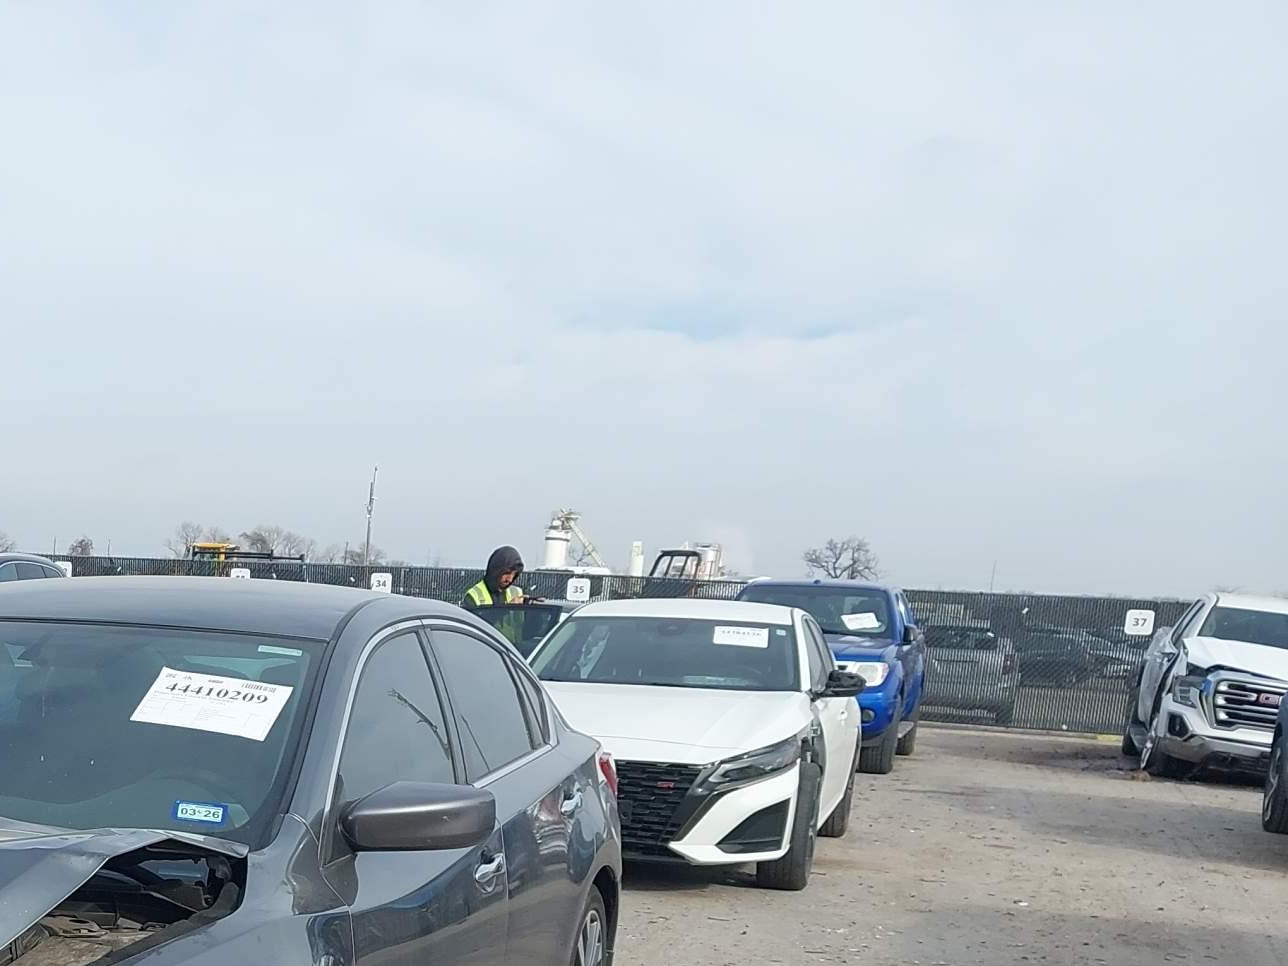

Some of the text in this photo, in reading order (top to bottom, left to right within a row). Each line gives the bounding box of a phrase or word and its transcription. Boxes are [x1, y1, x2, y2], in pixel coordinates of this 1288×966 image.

[375, 579, 387, 588] 34
[572, 585, 585, 594] 35
[1132, 617, 1147, 627] 37
[165, 682, 269, 704] 44410209
[180, 807, 220, 819] 03 26
